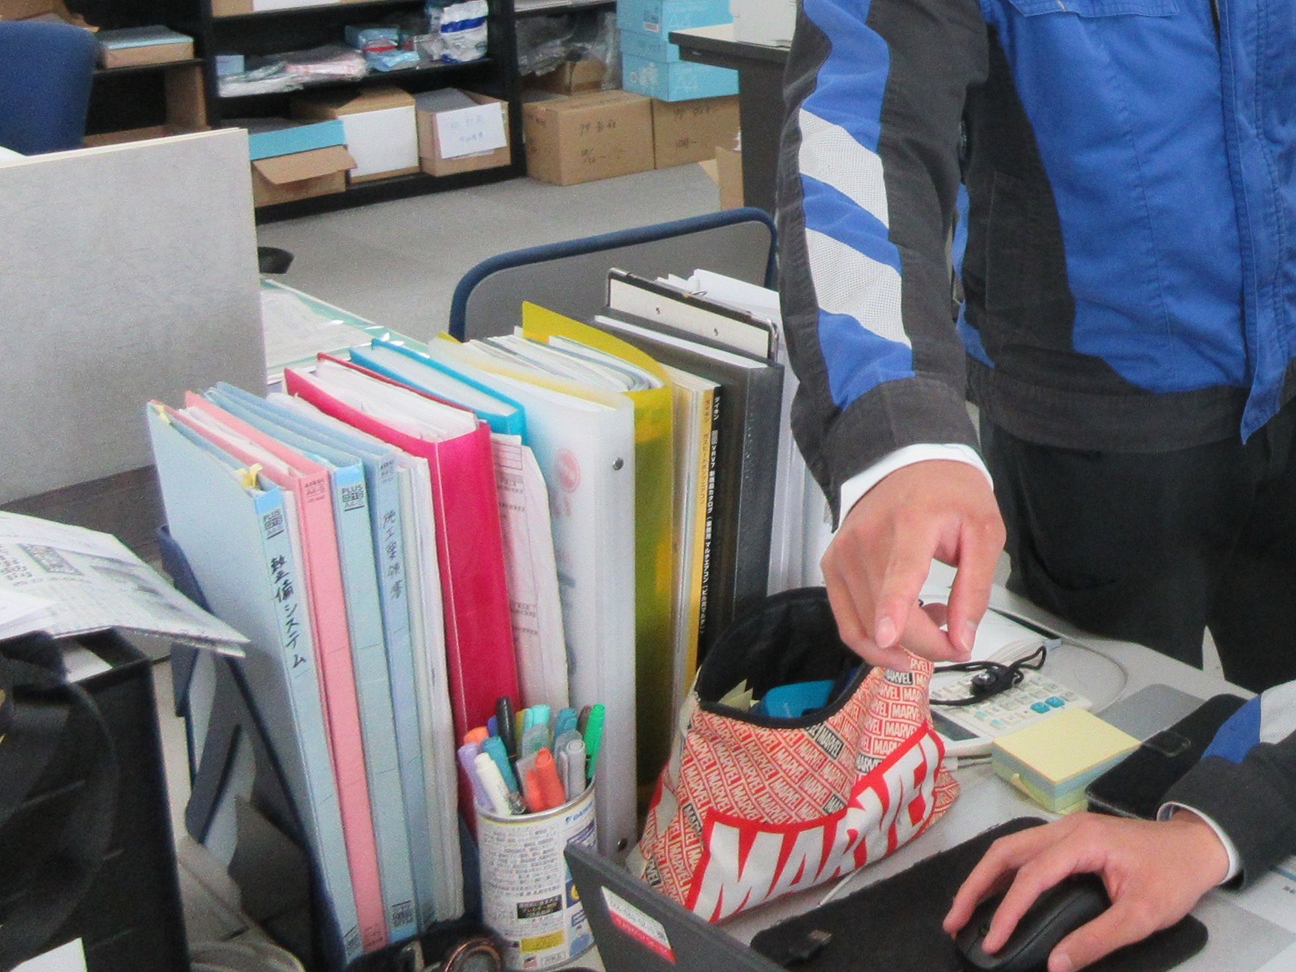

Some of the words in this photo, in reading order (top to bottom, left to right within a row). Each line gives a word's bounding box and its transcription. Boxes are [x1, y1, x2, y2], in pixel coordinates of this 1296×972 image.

[342, 484, 364, 495] PLUS
[270, 554, 307, 669] 整備システム
